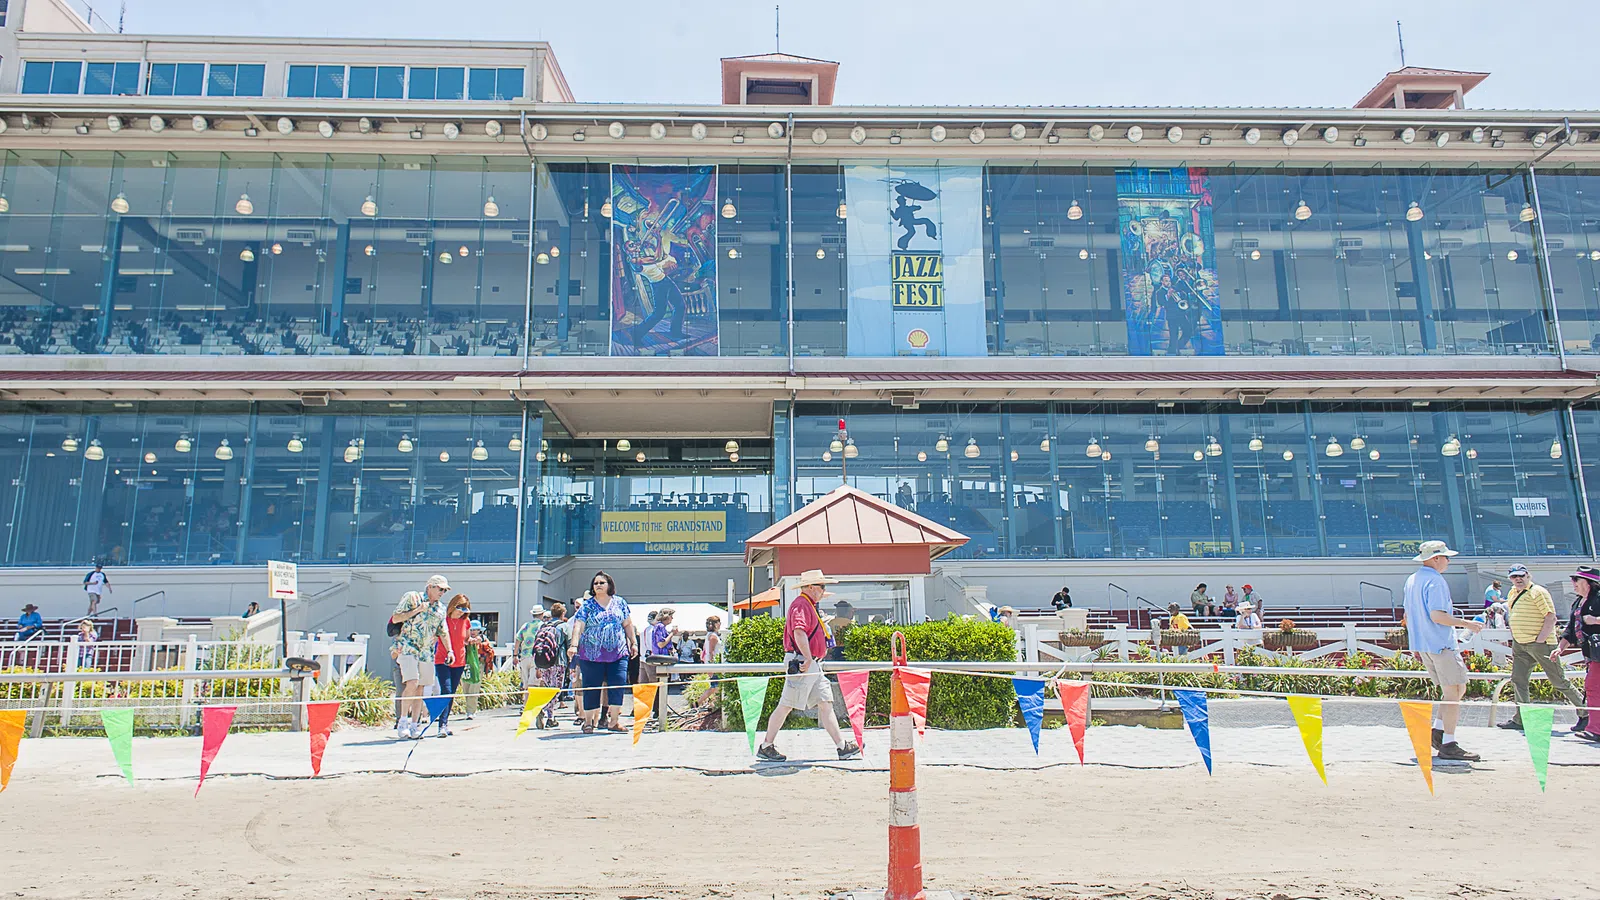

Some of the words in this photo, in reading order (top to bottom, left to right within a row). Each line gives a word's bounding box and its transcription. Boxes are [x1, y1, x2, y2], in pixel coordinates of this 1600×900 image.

[894, 256, 940, 280] JAZZ
[894, 284, 943, 305] FEST
[1515, 502, 1547, 511] EXHIBITS
[603, 520, 640, 532] WELCOME
[641, 522, 650, 532] TO
[651, 522, 662, 532] THE
[666, 520, 723, 532] GRANDSTAND
[644, 543, 685, 552] LAGNIAPPE
[686, 543, 709, 552] STAGE
